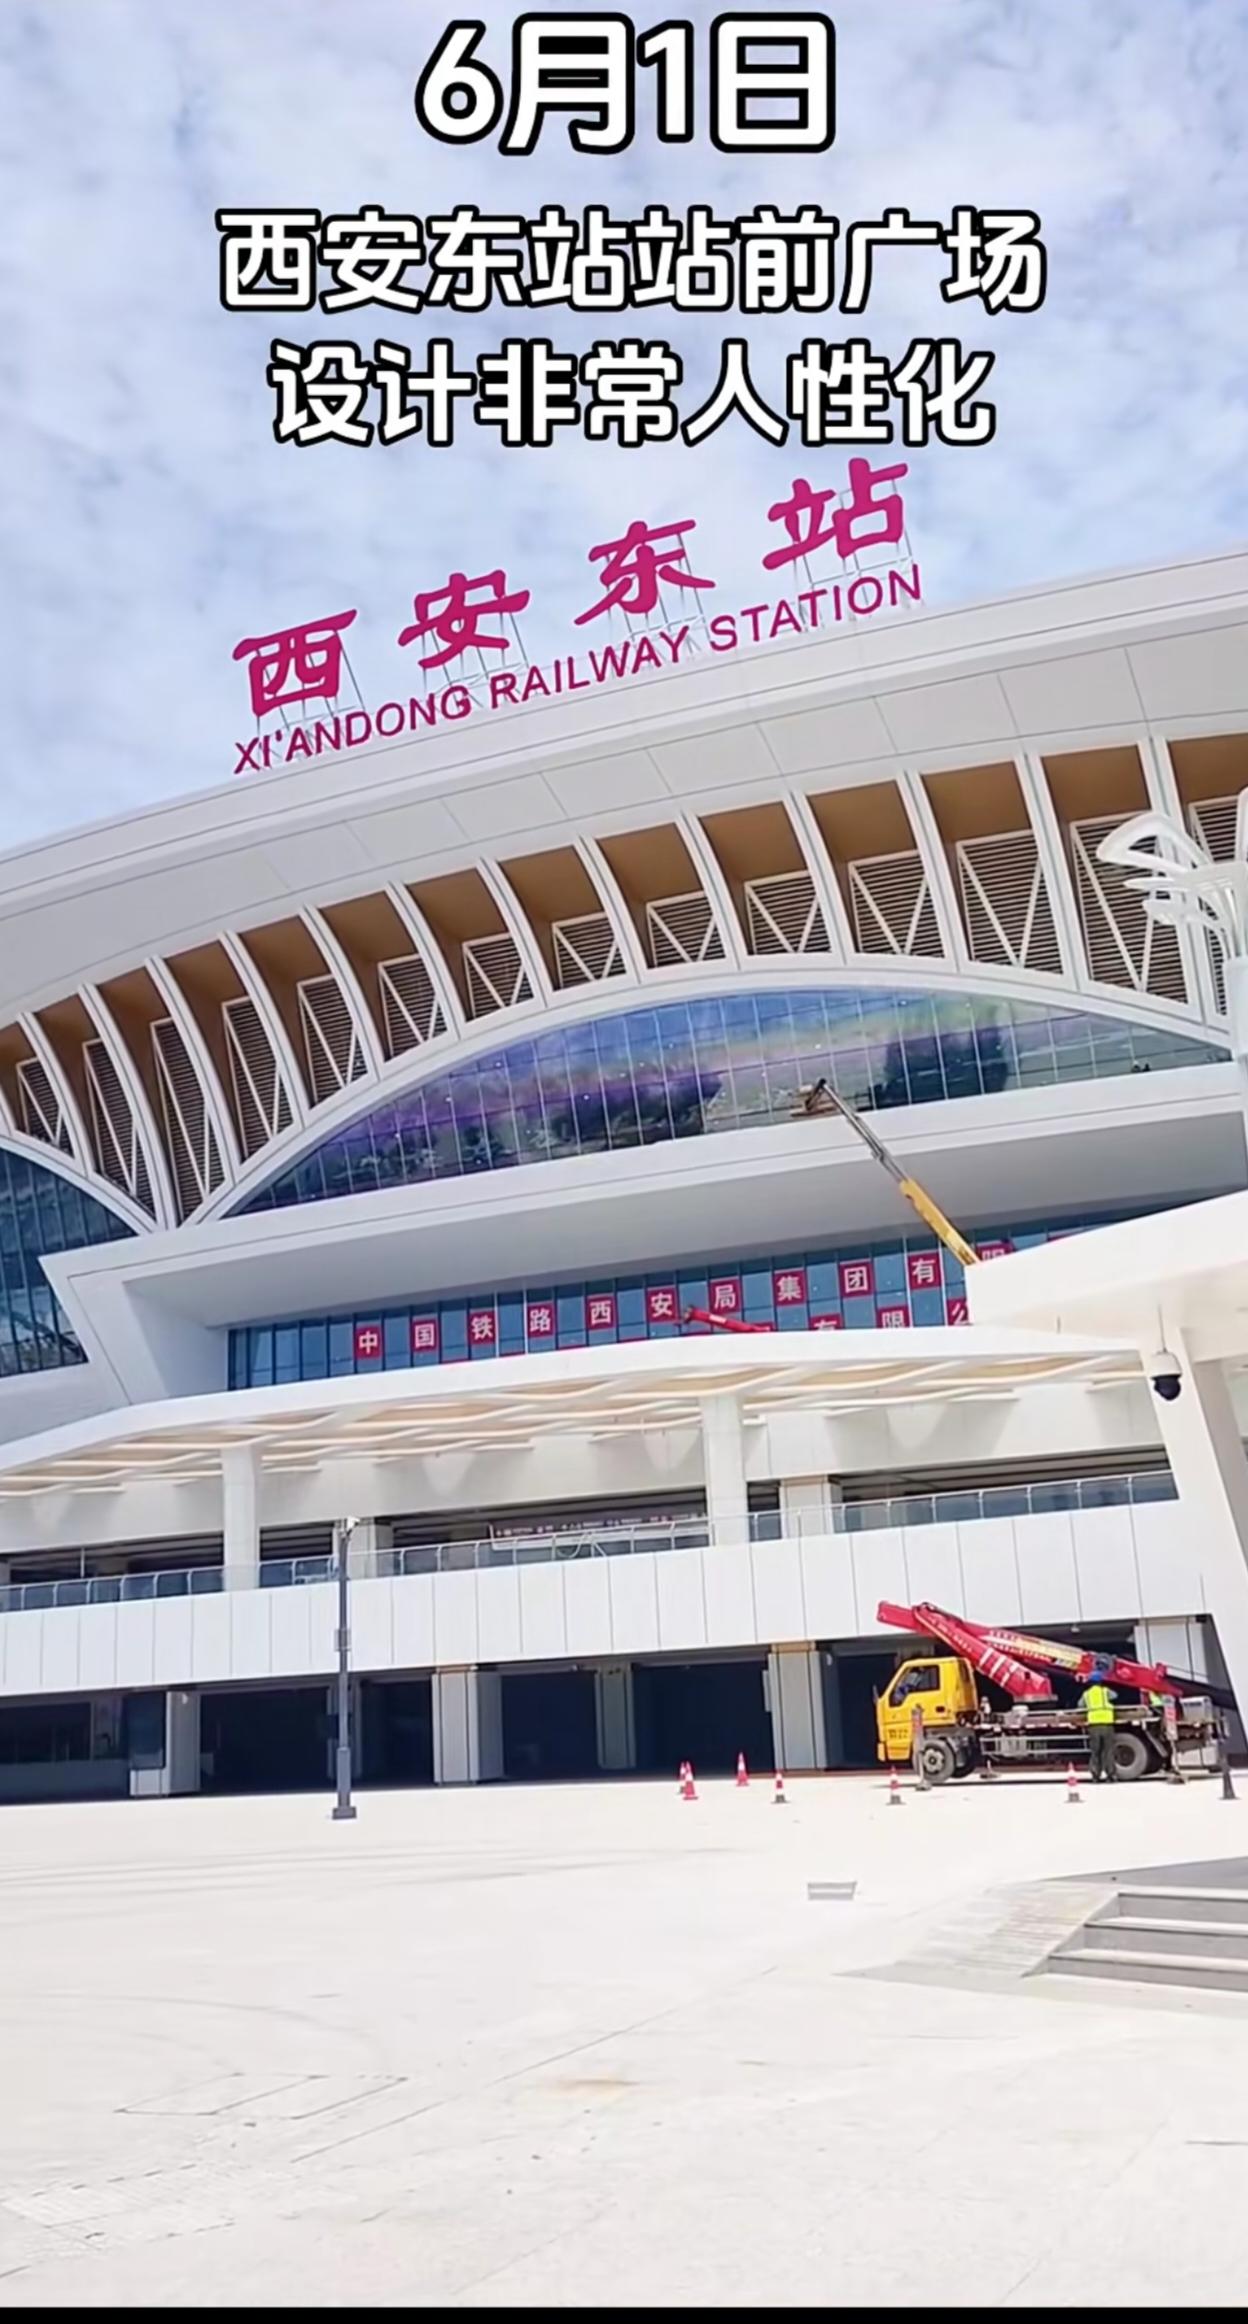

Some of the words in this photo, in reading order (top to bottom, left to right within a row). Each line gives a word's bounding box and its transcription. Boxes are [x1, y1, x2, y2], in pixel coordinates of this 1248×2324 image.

[233, 458, 908, 718] 西安东站
[234, 685, 472, 773] XI'ANDONG
[490, 626, 690, 709] RAILWAY
[709, 565, 922, 653] STATION
